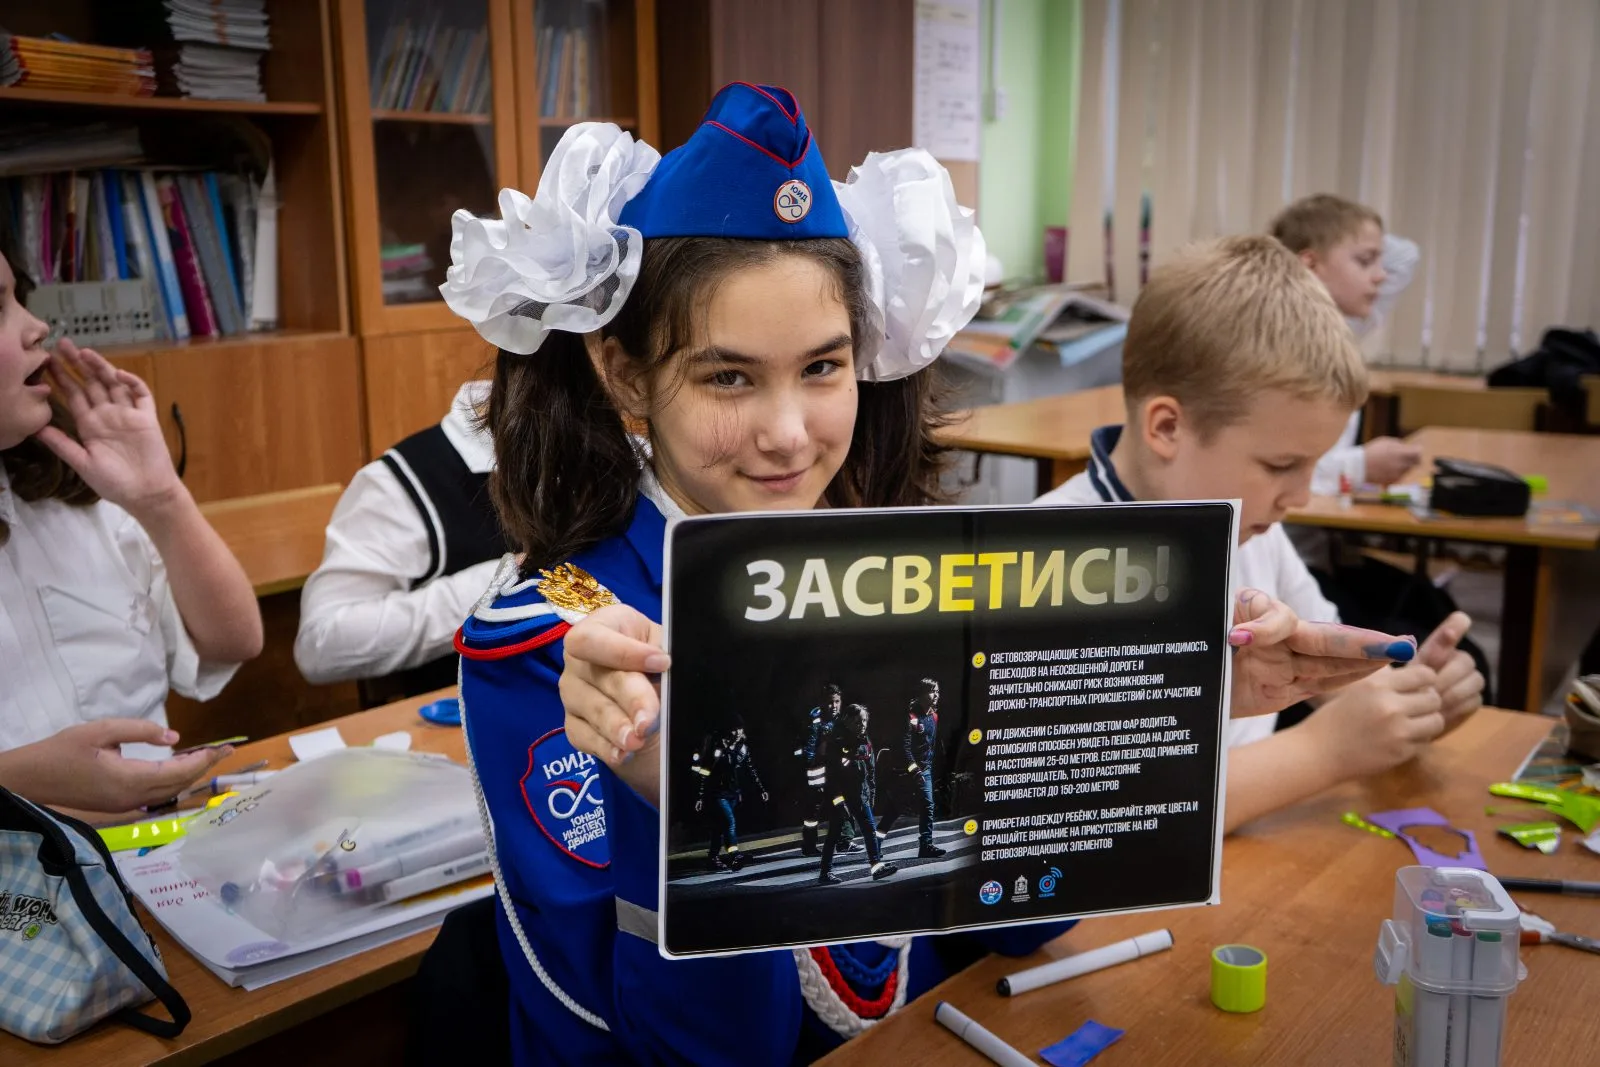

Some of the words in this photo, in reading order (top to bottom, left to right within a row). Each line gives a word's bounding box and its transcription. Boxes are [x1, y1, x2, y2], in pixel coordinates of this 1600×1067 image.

[790, 185, 808, 202] ЮИД
[744, 546, 1170, 622] ЗАСВЕТИСЬ!
[991, 649, 1079, 664] СВЕТОВОЗВРАЩАЮЩИЕ
[1080, 646, 1120, 658] ЭЛЕМЕНТЫ
[1122, 644, 1164, 656] ПОВЫШАЮТ
[1165, 641, 1208, 653] ВИДИМОСТЬ
[990, 667, 1036, 679] ПЕШЕХОДОВ
[1038, 666, 1048, 676] НА
[1050, 661, 1109, 676] НЕОСВЕЩЕННОЙ
[1109, 660, 1137, 673] ДОРОГЕ
[1139, 660, 1144, 670] И
[989, 682, 1043, 695] ЗНАЧИТЕЛЬНО
[1044, 679, 1082, 691] СНИЖАЮТ
[1084, 678, 1103, 689] РИСК
[1104, 674, 1164, 687] ВОЗНИКНОВЕНИЯ
[988, 695, 1087, 712] ДОРОЖНО-ТРАНСПОРТНЫХ
[1088, 689, 1146, 704] ПРОИСШЕСТВИЙ
[1146, 690, 1151, 699] С
[1152, 689, 1162, 699] ИХ
[1164, 686, 1201, 698] УЧАСТИЕМ
[987, 729, 1002, 740] ПРИ
[1003, 726, 1046, 740] ДВИЖЕНИИ
[1047, 725, 1052, 735] С
[1054, 723, 1092, 735] БЛИЖНИМ
[1093, 720, 1121, 732] СВЕТОМ
[1123, 719, 1139, 729] ФАР
[1140, 716, 1177, 728] ВОДИТЕЛЬ
[986, 742, 1036, 756] АВТОМОБИЛЯ
[1038, 739, 1075, 751] СПОСОБЕН
[1077, 736, 1110, 748] УВИДЕТЬ
[1111, 733, 1150, 745] ПЕШЕХОДА
[1152, 732, 1162, 742] НА
[1163, 730, 1190, 742] ДОРОГЕ
[542, 751, 596, 780] ЮИД
[986, 761, 996, 771] НА
[997, 757, 1045, 770] РАССТОЯНИИ
[1047, 755, 1068, 766] 25-50
[1070, 752, 1099, 764] МЕТРОВ.
[1101, 750, 1120, 761] ЕСЛИ
[1121, 747, 1156, 759] ПЕШЕХОД
[1157, 744, 1199, 756] ПРИМЕНЯЕТ
[985, 770, 1068, 786] СВЕТОВОЗВРАЩАТЕЛЬ,
[1071, 769, 1079, 779] ТО
[1081, 767, 1094, 778] ЭТО
[1096, 763, 1141, 776] РАССТОЯНИЕ
[985, 787, 1046, 802] УВЕЛИЧИВАЕТСЯ
[1047, 786, 1058, 797] ДО
[1061, 783, 1090, 794] 150-200
[1091, 780, 1119, 792] МЕТРОВ
[570, 806, 605, 828] ЮНЫЙ
[983, 816, 1030, 830] ПРИОБРЕТАЯ
[1031, 813, 1064, 826] ОДЕЖДУ
[1066, 810, 1099, 822] РЕБЁНКУ,
[1101, 805, 1143, 819] ВЫБИРАЙТЕ
[1145, 804, 1167, 815] ЯРКИЕ
[1169, 802, 1191, 814] ЦВЕТА
[1193, 801, 1198, 811] И
[982, 831, 1027, 846] ОБРАЩАЙТЕ
[1029, 827, 1068, 841] ВНИМАНИЕ
[1070, 826, 1079, 836] НА
[1081, 822, 1131, 835] ПРИСУТСТВИЕ
[1132, 821, 1142, 831] НА
[1144, 818, 1157, 830] НЕЙ
[982, 842, 1068, 861] СВЕТОВОЗВРАЩАЮЩИХ
[1070, 838, 1112, 851] ЭЛЕМЕНТОВ
